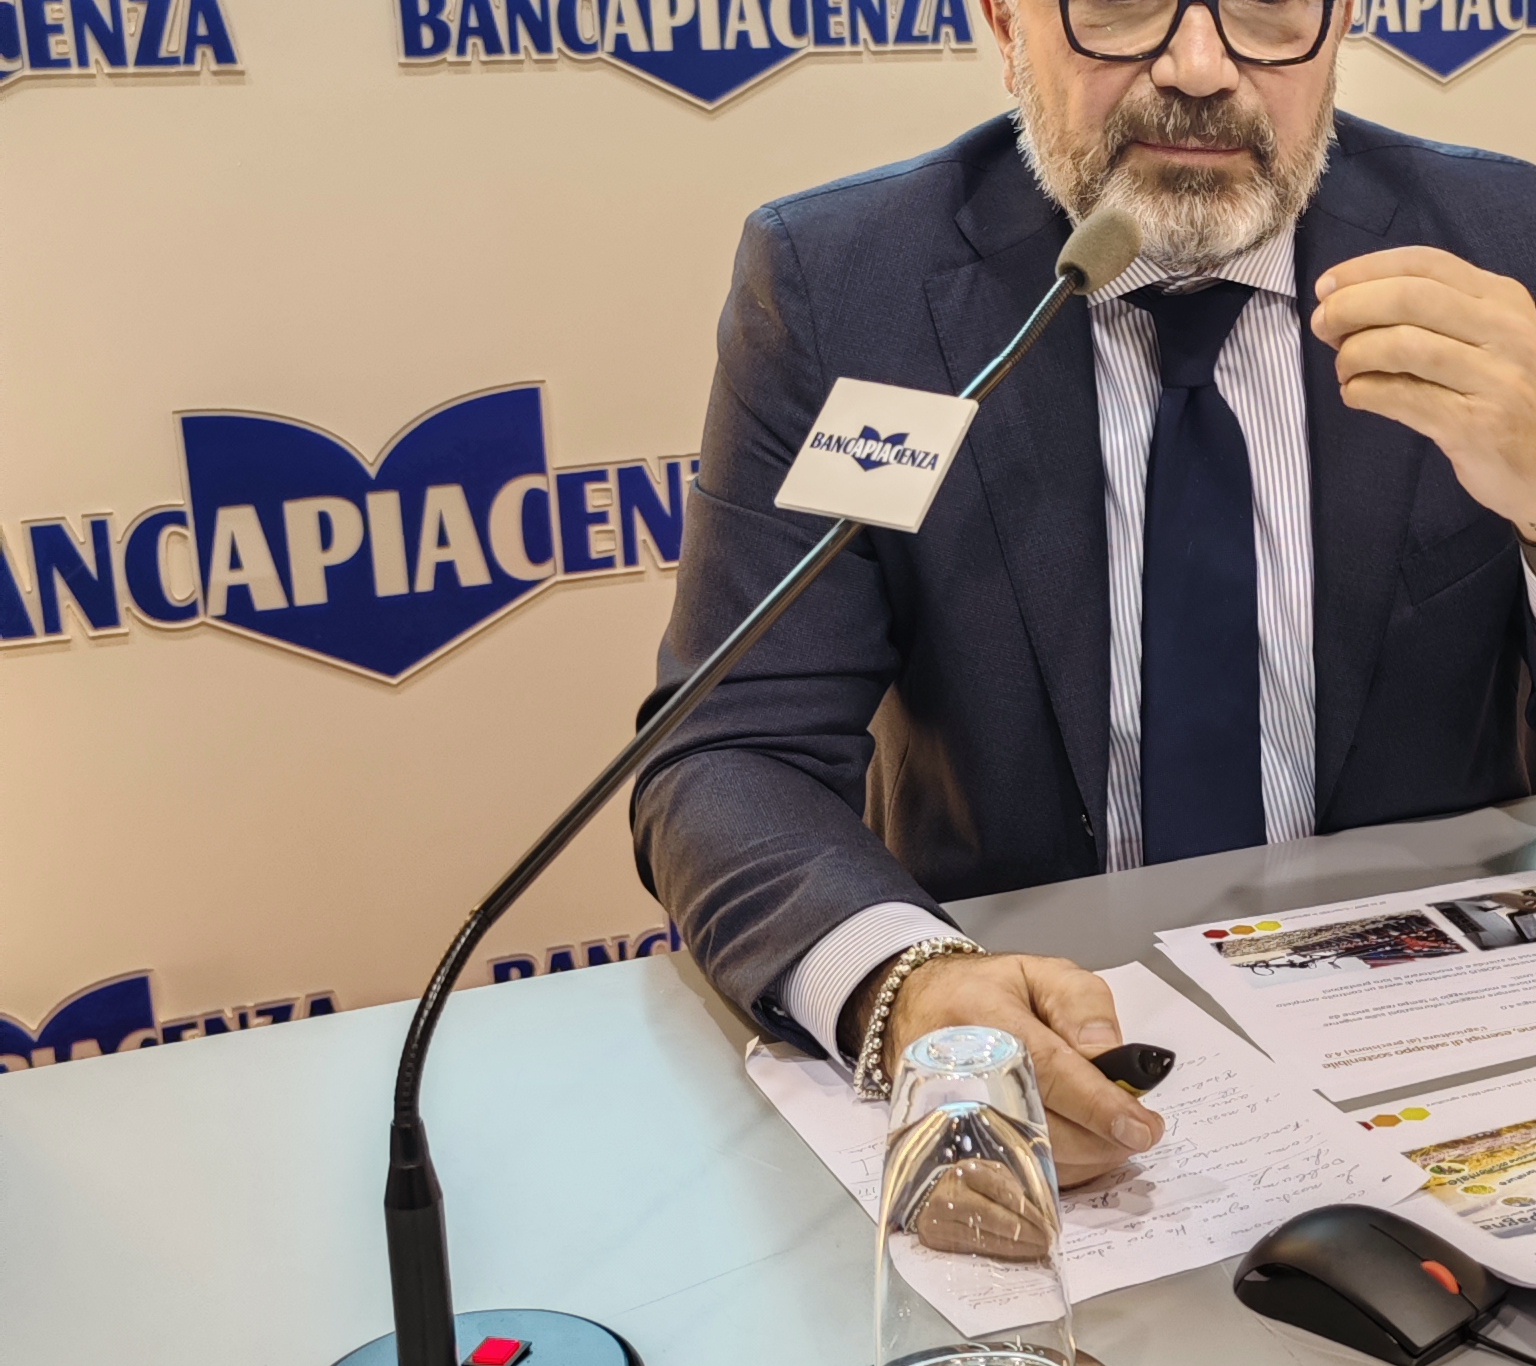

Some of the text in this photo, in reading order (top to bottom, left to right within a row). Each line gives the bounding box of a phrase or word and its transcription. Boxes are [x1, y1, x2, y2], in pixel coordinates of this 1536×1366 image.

[809, 431, 940, 471] BANCAPIACENZA
[0, 459, 700, 639] NCAPIACEN
[1321, 1051, 1393, 1070] sostenibile
